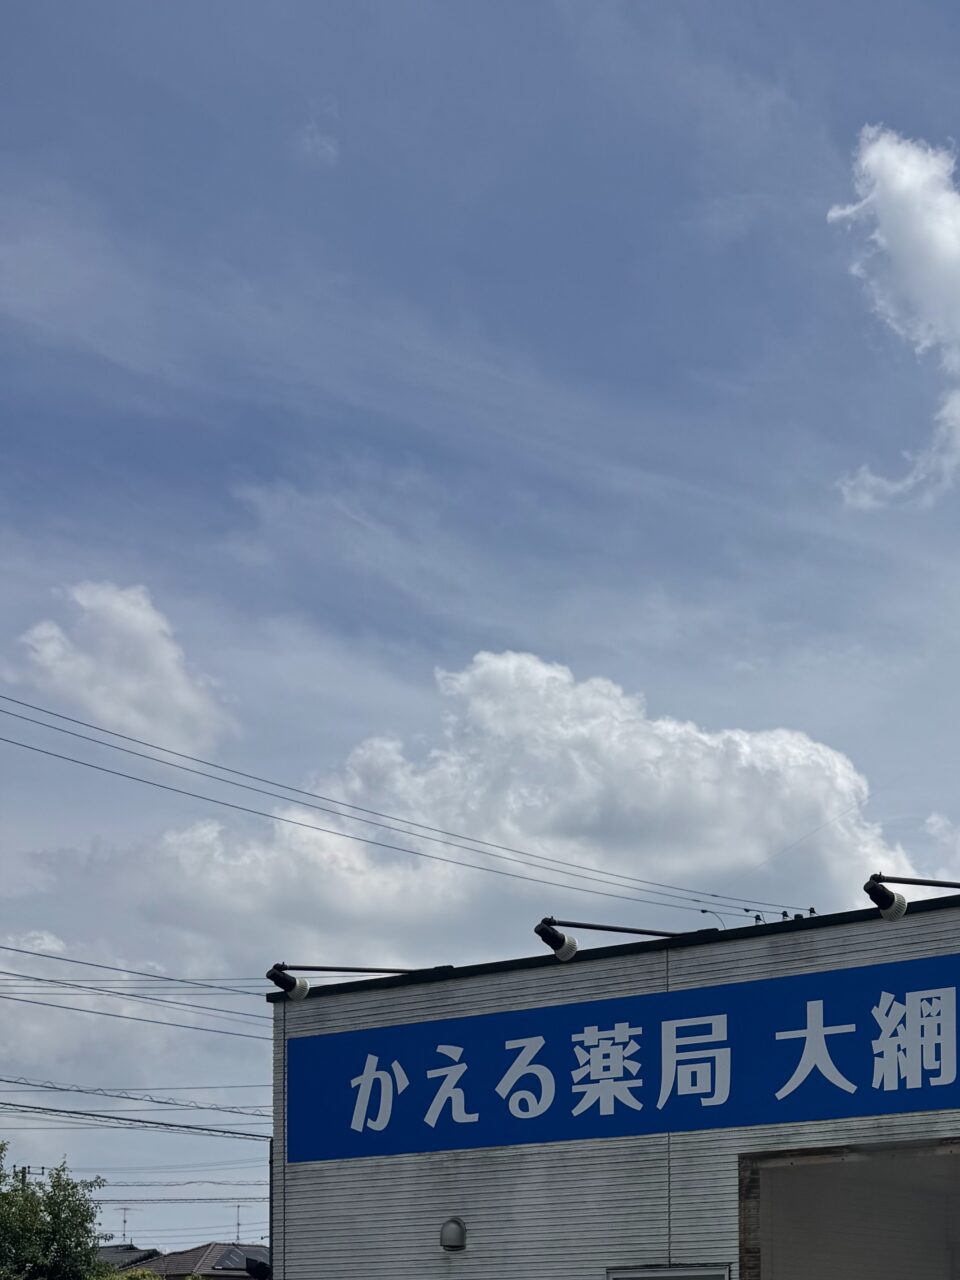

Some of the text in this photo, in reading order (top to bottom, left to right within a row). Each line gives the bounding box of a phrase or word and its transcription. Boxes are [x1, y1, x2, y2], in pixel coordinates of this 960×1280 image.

[349, 1013, 733, 1133] かえる薬局
